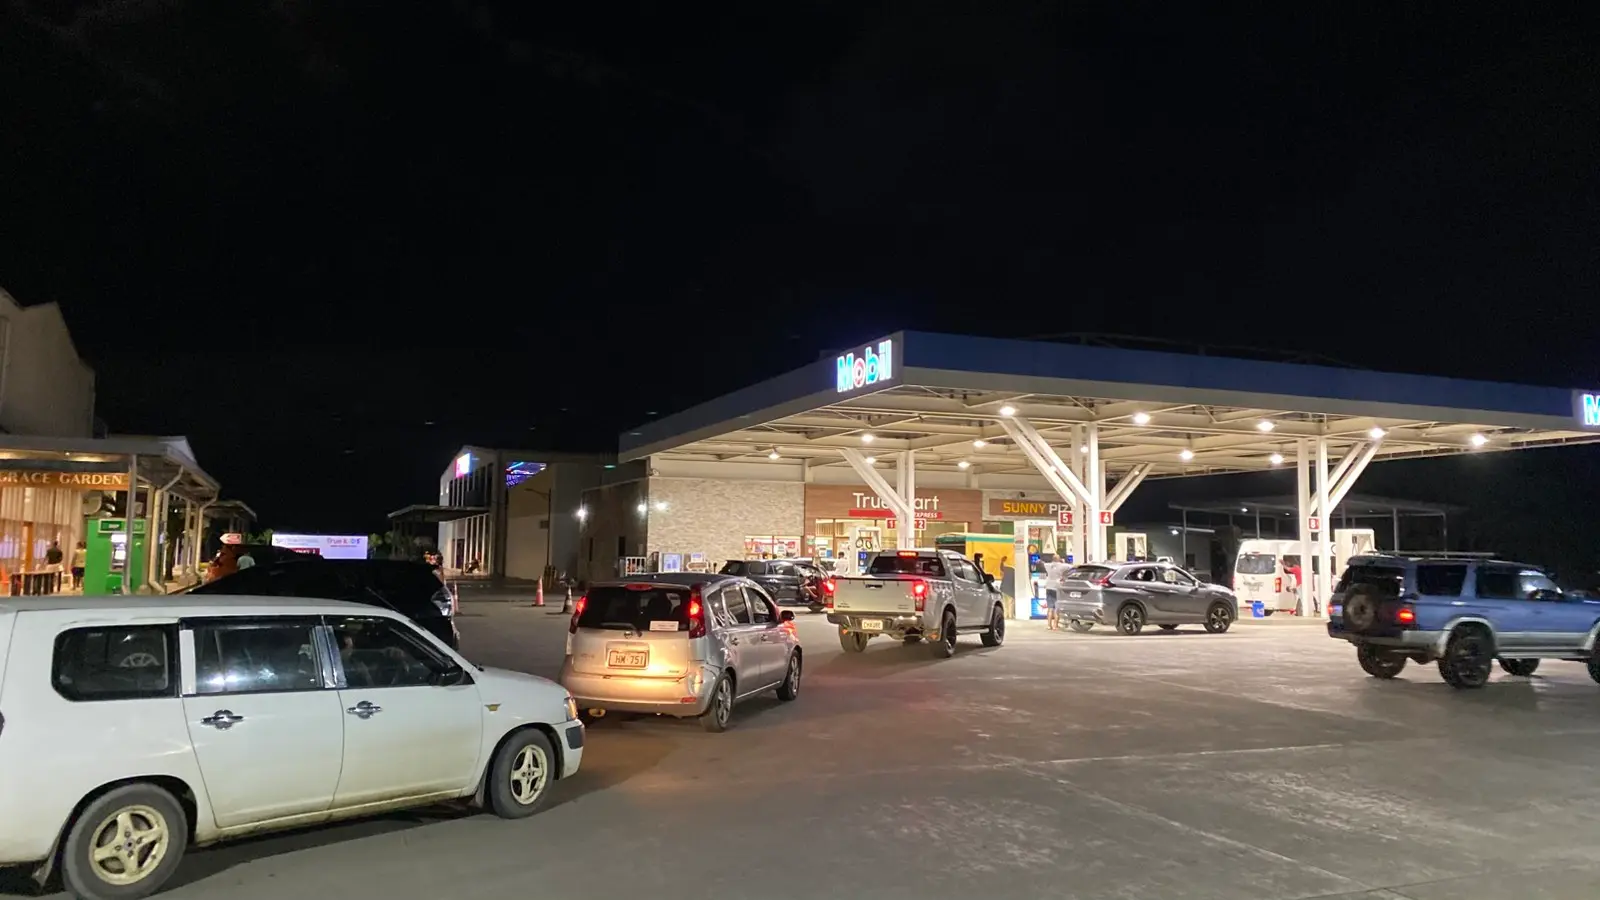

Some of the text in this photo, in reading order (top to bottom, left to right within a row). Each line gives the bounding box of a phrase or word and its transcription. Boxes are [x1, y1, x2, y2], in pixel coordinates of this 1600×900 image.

[837, 339, 892, 393] Mobil
[60, 473, 123, 485] GARDEN
[852, 492, 940, 511] Trueart
[1003, 502, 1046, 514] SUNNY
[1062, 513, 1069, 524] 5
[1103, 513, 1110, 523] 6
[918, 520, 924, 529] 2
